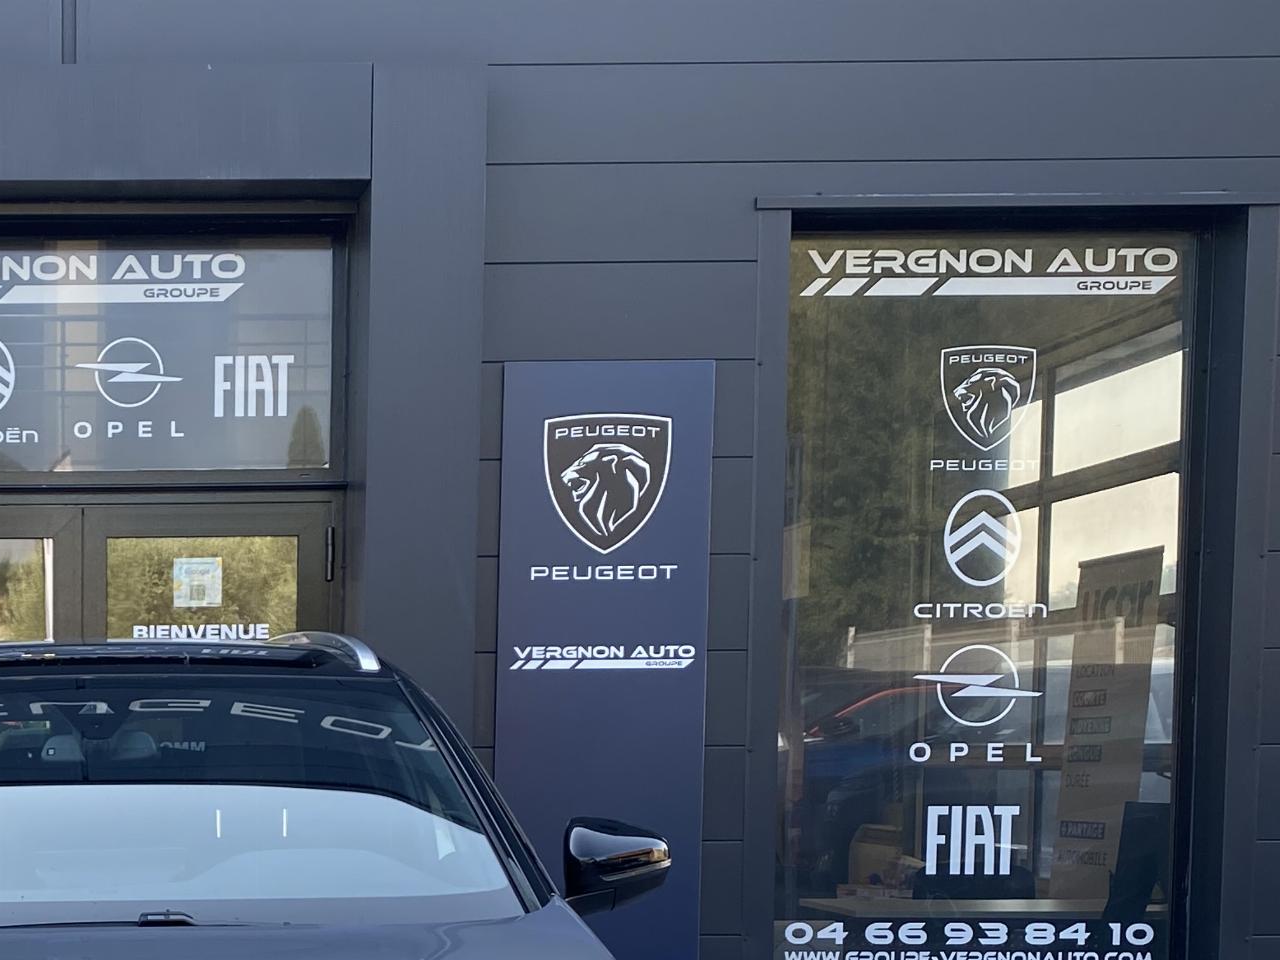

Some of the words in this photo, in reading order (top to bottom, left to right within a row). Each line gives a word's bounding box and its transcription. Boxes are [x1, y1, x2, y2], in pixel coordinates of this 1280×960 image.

[112, 253, 245, 280] AUTO
[808, 249, 1032, 274] VERGNON
[1047, 248, 1178, 273] AUTO
[143, 287, 220, 298] GROUPE
[1077, 280, 1152, 291] GROUPE
[949, 354, 1028, 364] PEUGEOT
[214, 355, 294, 417] FIAT
[74, 421, 185, 438] OPEL
[555, 425, 660, 439] PEUGEOT
[930, 460, 1040, 471] PEUGEOT
[531, 565, 677, 580] PEUGEOT
[133, 624, 269, 640] BIENVENUE
[513, 646, 624, 659] VERGNON
[631, 645, 696, 658] AUTO
[909, 742, 1042, 762] OPEL
[925, 806, 1019, 875] FIAT
[784, 922, 848, 944] 04
[865, 922, 927, 944] 66
[944, 922, 1008, 944] 93
[1024, 922, 1091, 944] 84
[1109, 922, 1154, 944] 10
